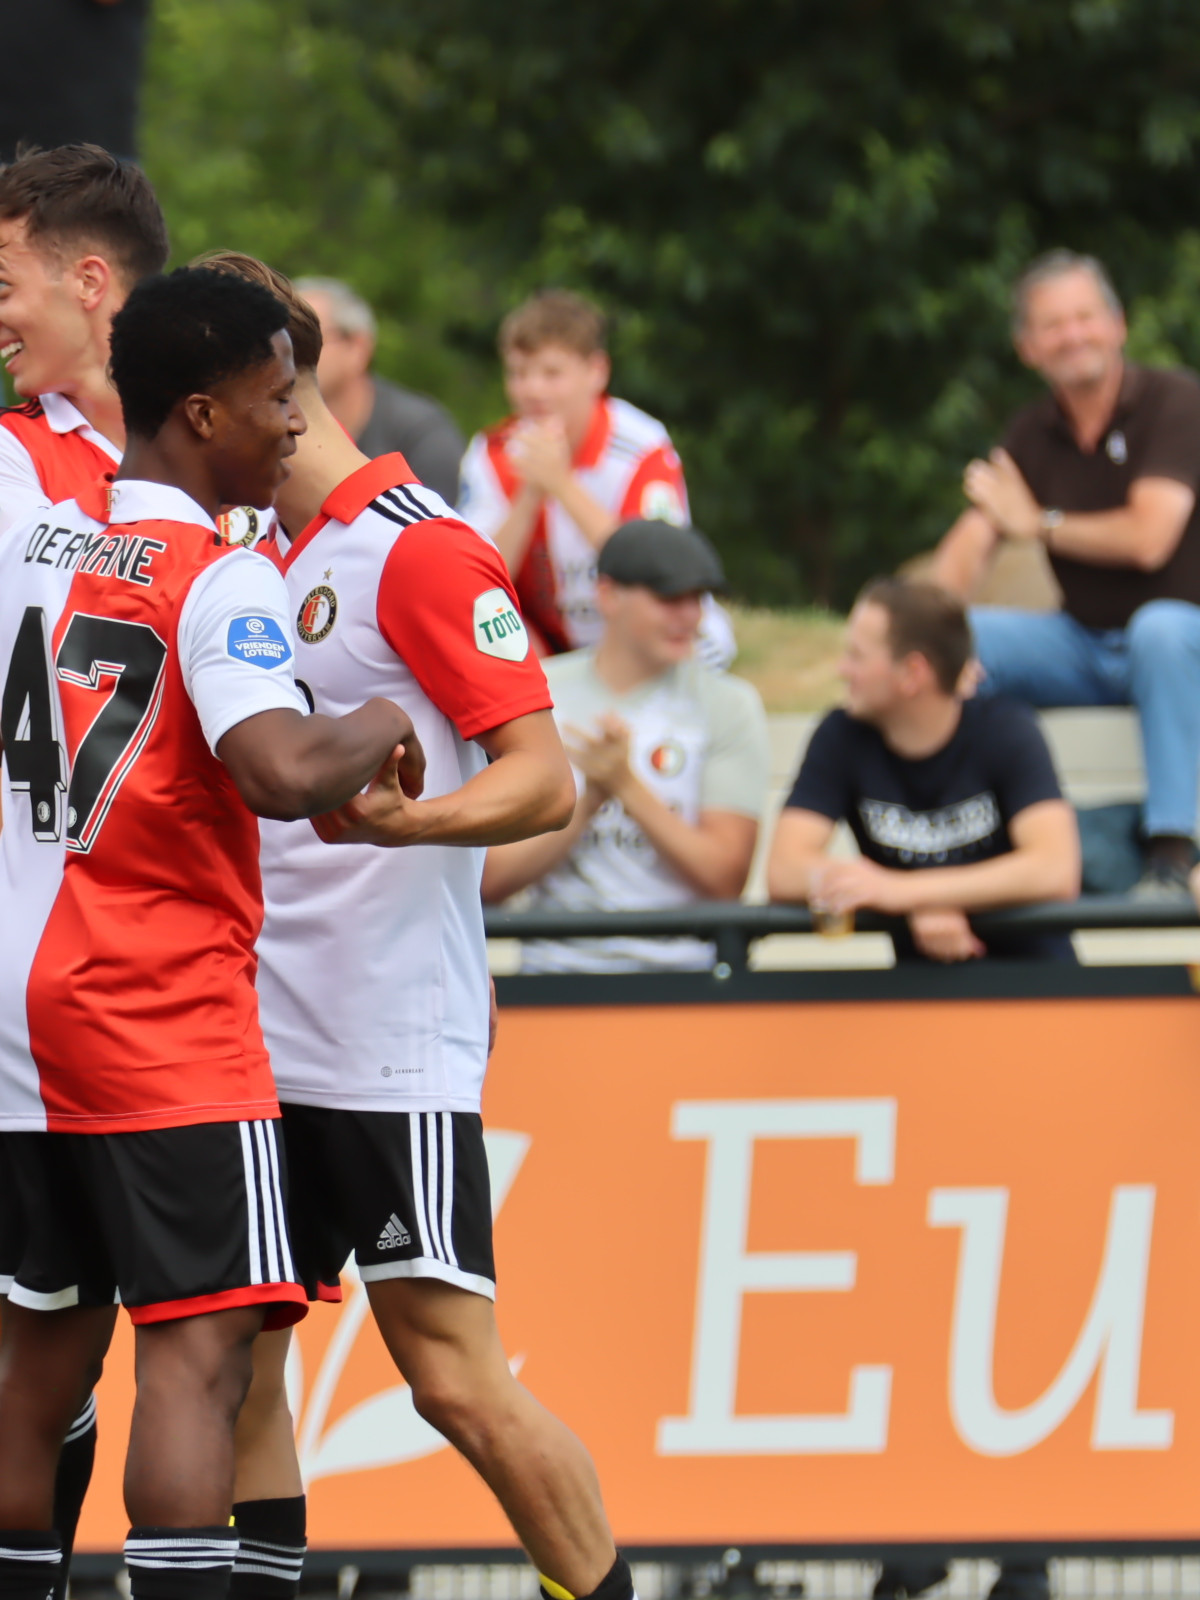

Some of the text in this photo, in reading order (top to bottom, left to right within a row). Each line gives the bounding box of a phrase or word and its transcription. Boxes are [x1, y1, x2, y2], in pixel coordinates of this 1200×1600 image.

[24, 522, 168, 587] DERMANE
[478, 610, 521, 644] TOTO
[234, 641, 286, 652] VRIENDEN
[243, 649, 282, 659] LOTERIJ
[0, 605, 169, 856] 47
[376, 1233, 412, 1250] adida
[655, 1096, 1176, 1457] Eu
